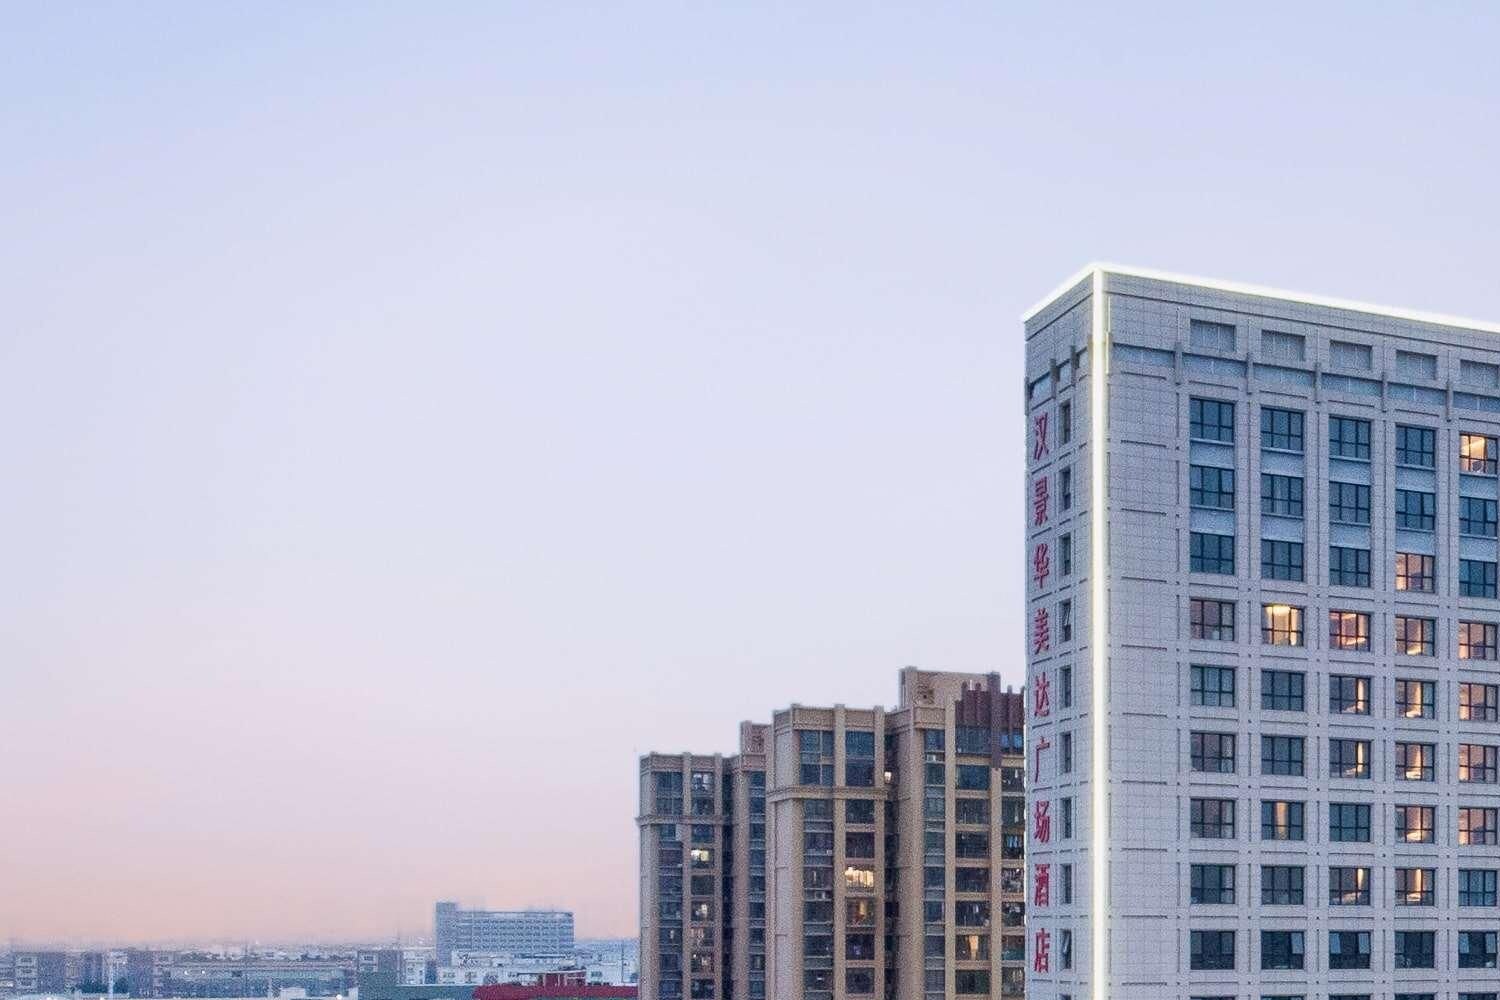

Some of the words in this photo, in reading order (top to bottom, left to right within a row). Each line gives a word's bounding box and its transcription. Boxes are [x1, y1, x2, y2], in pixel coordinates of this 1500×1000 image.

[1033, 411, 1050, 973] 汉景华美达广场酒店
